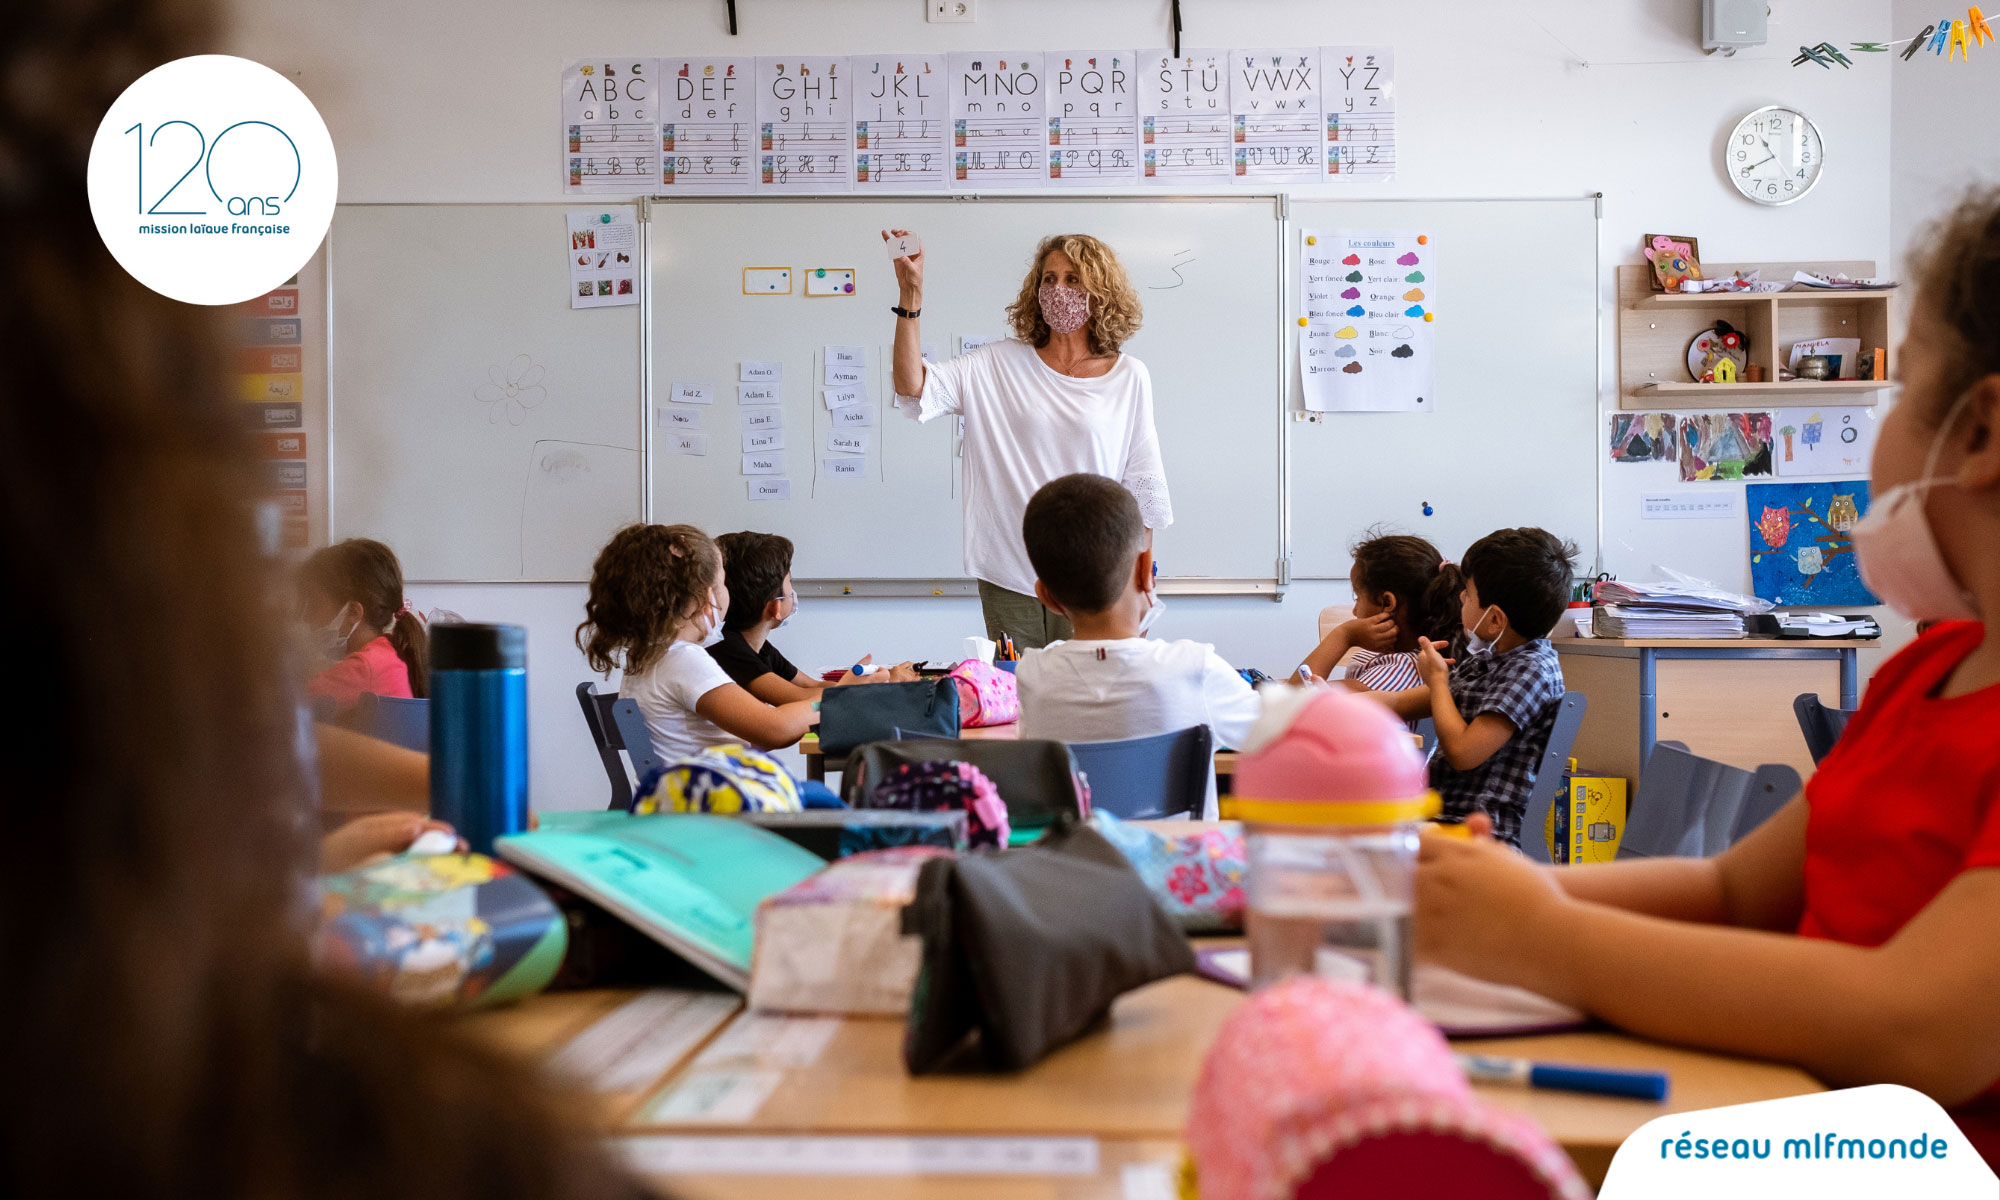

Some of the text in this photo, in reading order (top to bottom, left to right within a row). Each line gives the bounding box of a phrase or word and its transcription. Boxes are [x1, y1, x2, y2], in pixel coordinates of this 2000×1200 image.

[1754, 122, 1764, 133] 11
[1770, 119, 1782, 130] 12
[1790, 123, 1794, 133] 1
[1742, 134, 1755, 146] 10
[1801, 135, 1808, 147] 2
[1737, 150, 1747, 162] 9
[1741, 167, 1751, 178] 8
[1796, 168, 1806, 179] 4
[1753, 179, 1762, 191] 7
[1767, 183, 1778, 195] 6
[1784, 180, 1794, 191] 5
[900, 241, 906, 253] 4
[1348, 239, 1396, 248] Les couleurs
[1309, 275, 1323, 283] Vert
[1309, 311, 1324, 319] Bleu
[1368, 311, 1382, 319] Bleu
[833, 373, 858, 381] Ayman
[682, 389, 694, 397] Jad
[837, 393, 855, 402] Lilya
[844, 413, 864, 421] Aicha
[680, 441, 691, 449] Ali
[833, 439, 852, 447] Sarah
